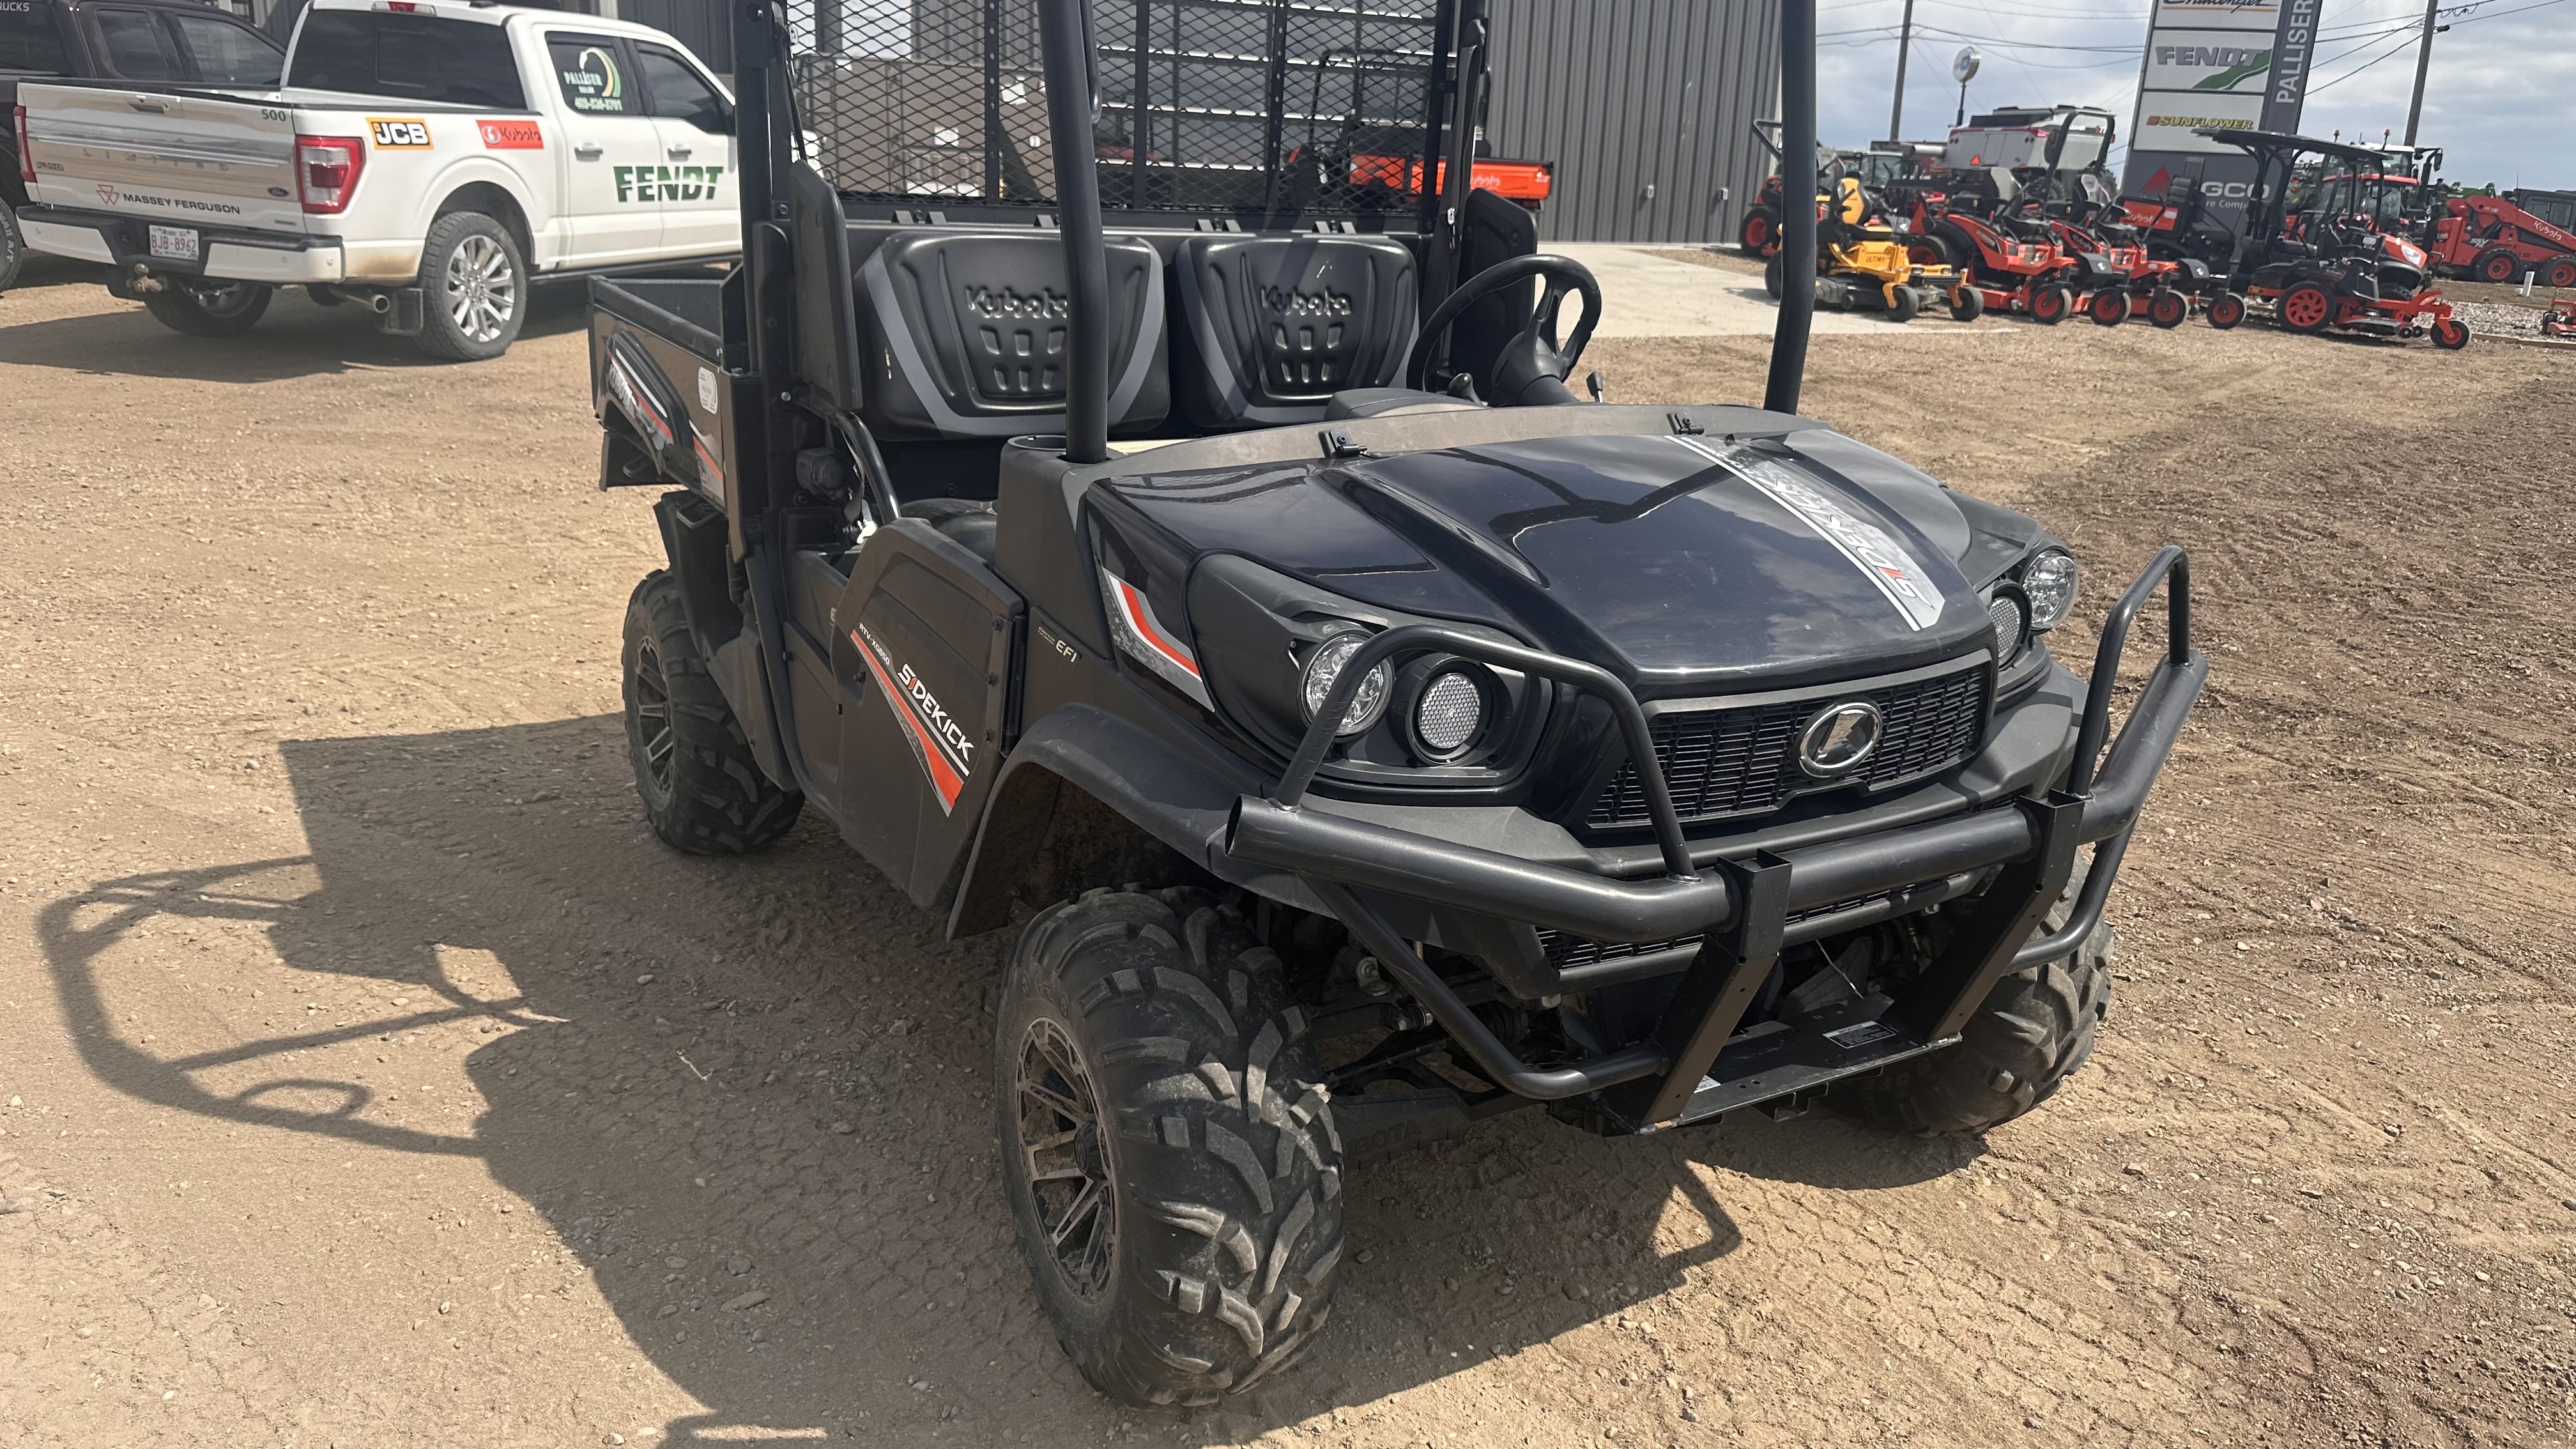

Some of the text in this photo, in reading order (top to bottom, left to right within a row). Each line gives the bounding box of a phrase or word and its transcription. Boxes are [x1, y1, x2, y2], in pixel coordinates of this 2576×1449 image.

[2156, 46, 2266, 67] FENDT
[2275, 0, 2313, 103] PALLISER
[261, 109, 286, 121] 500
[2159, 116, 2254, 129] SUNFLOWER
[376, 122, 429, 145] JCB
[499, 126, 542, 141] Kubota
[613, 166, 724, 203] FENDT
[1471, 174, 1499, 187] ubota
[2200, 181, 2270, 199] GCO
[123, 194, 240, 215] MASSEY FERGUSON
[2533, 220, 2562, 241] Kubota
[1260, 285, 1351, 317] Kubota
[1055, 640, 1078, 663] EFI
[896, 663, 974, 762] SIDEKICK
